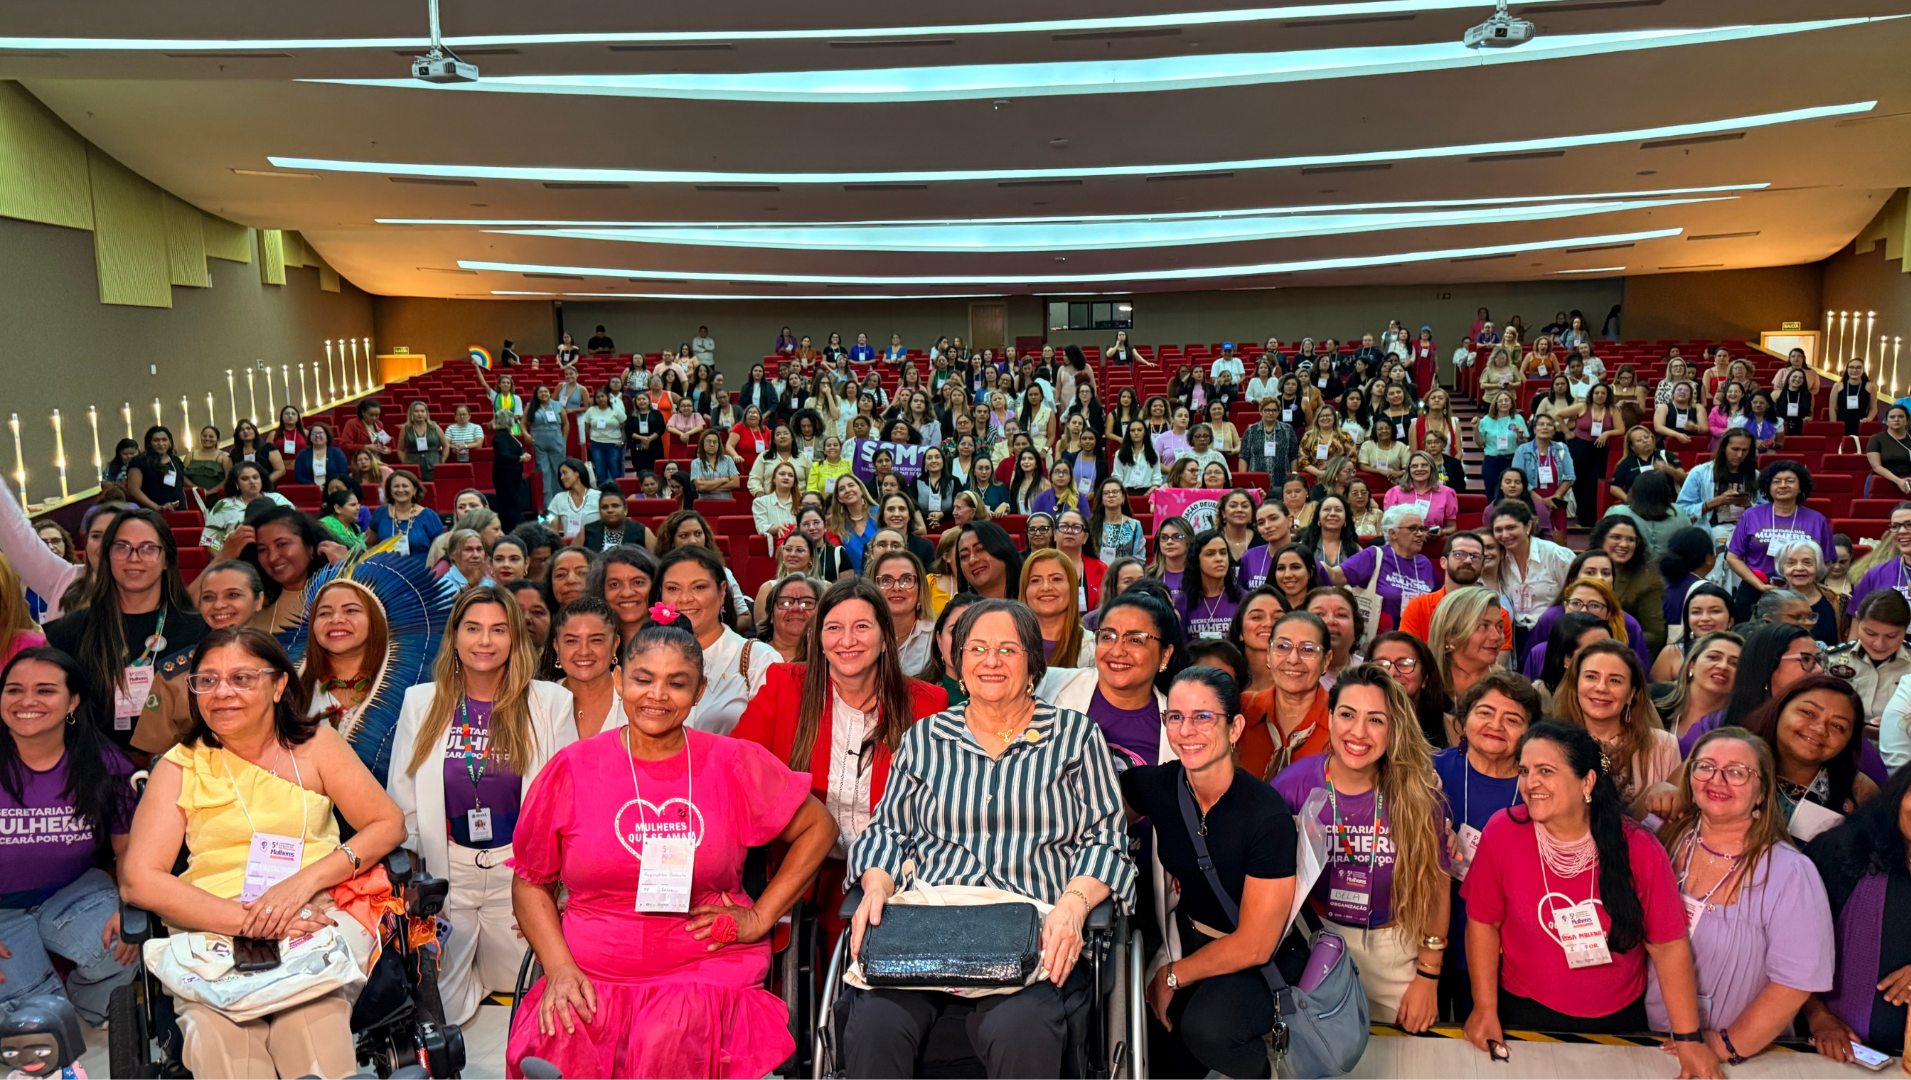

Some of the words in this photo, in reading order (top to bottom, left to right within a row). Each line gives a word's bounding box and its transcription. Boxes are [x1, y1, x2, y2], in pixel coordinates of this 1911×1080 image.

[860, 440, 929, 466] SSM
[1187, 622, 1231, 635] MULHER
[450, 726, 490, 738] CRTAR
[0, 814, 95, 835] ULHER
[635, 822, 688, 833] MULHERES
[1324, 824, 1374, 835] CRTARIA
[36, 834, 59, 844] POR
[1326, 835, 1396, 854] ULHER
[1330, 901, 1368, 912] ORGANIZAÇÃO
